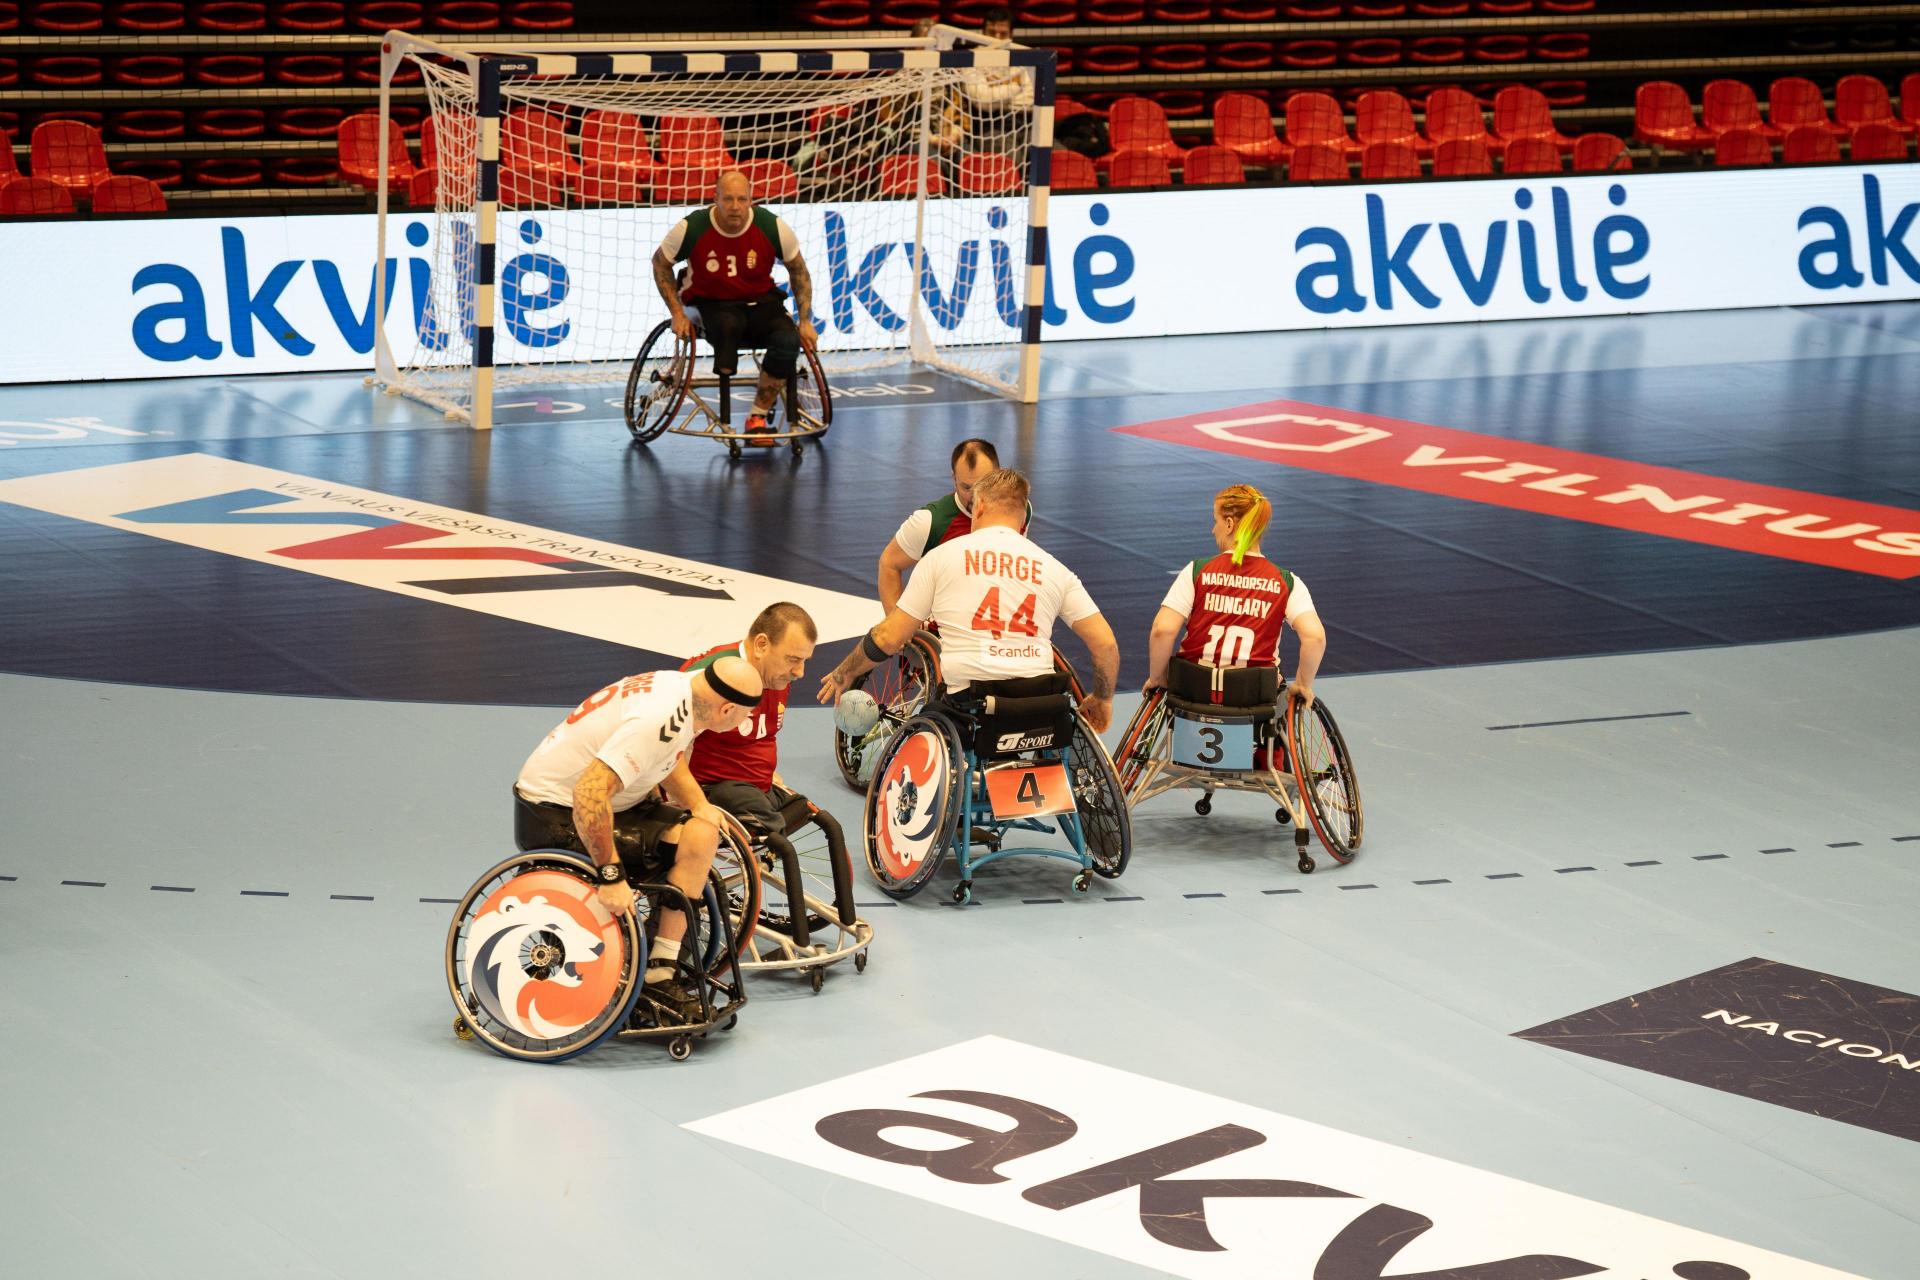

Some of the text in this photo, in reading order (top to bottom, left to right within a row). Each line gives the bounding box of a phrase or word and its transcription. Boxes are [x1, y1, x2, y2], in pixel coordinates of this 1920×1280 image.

[726, 255, 738, 277] 3
[1295, 184, 1650, 314] akvilė
[132, 219, 571, 362] akvilė
[1402, 445, 1920, 556] VILNIUS
[275, 482, 735, 586] VILNIAUS VIEŠASIS TRANSPORTAS
[964, 549, 1043, 586] NORGE
[1201, 572, 1281, 595] MAGYARORSZÁG
[971, 586, 1039, 640] 44
[1203, 593, 1272, 619] HUNGARY
[989, 645, 1041, 658] Scandic
[1198, 624, 1255, 669] 10
[1017, 733, 1055, 750] SPORT
[1196, 727, 1224, 765] 3
[1017, 772, 1045, 808] 4
[1701, 1009, 1920, 1073] NACION
